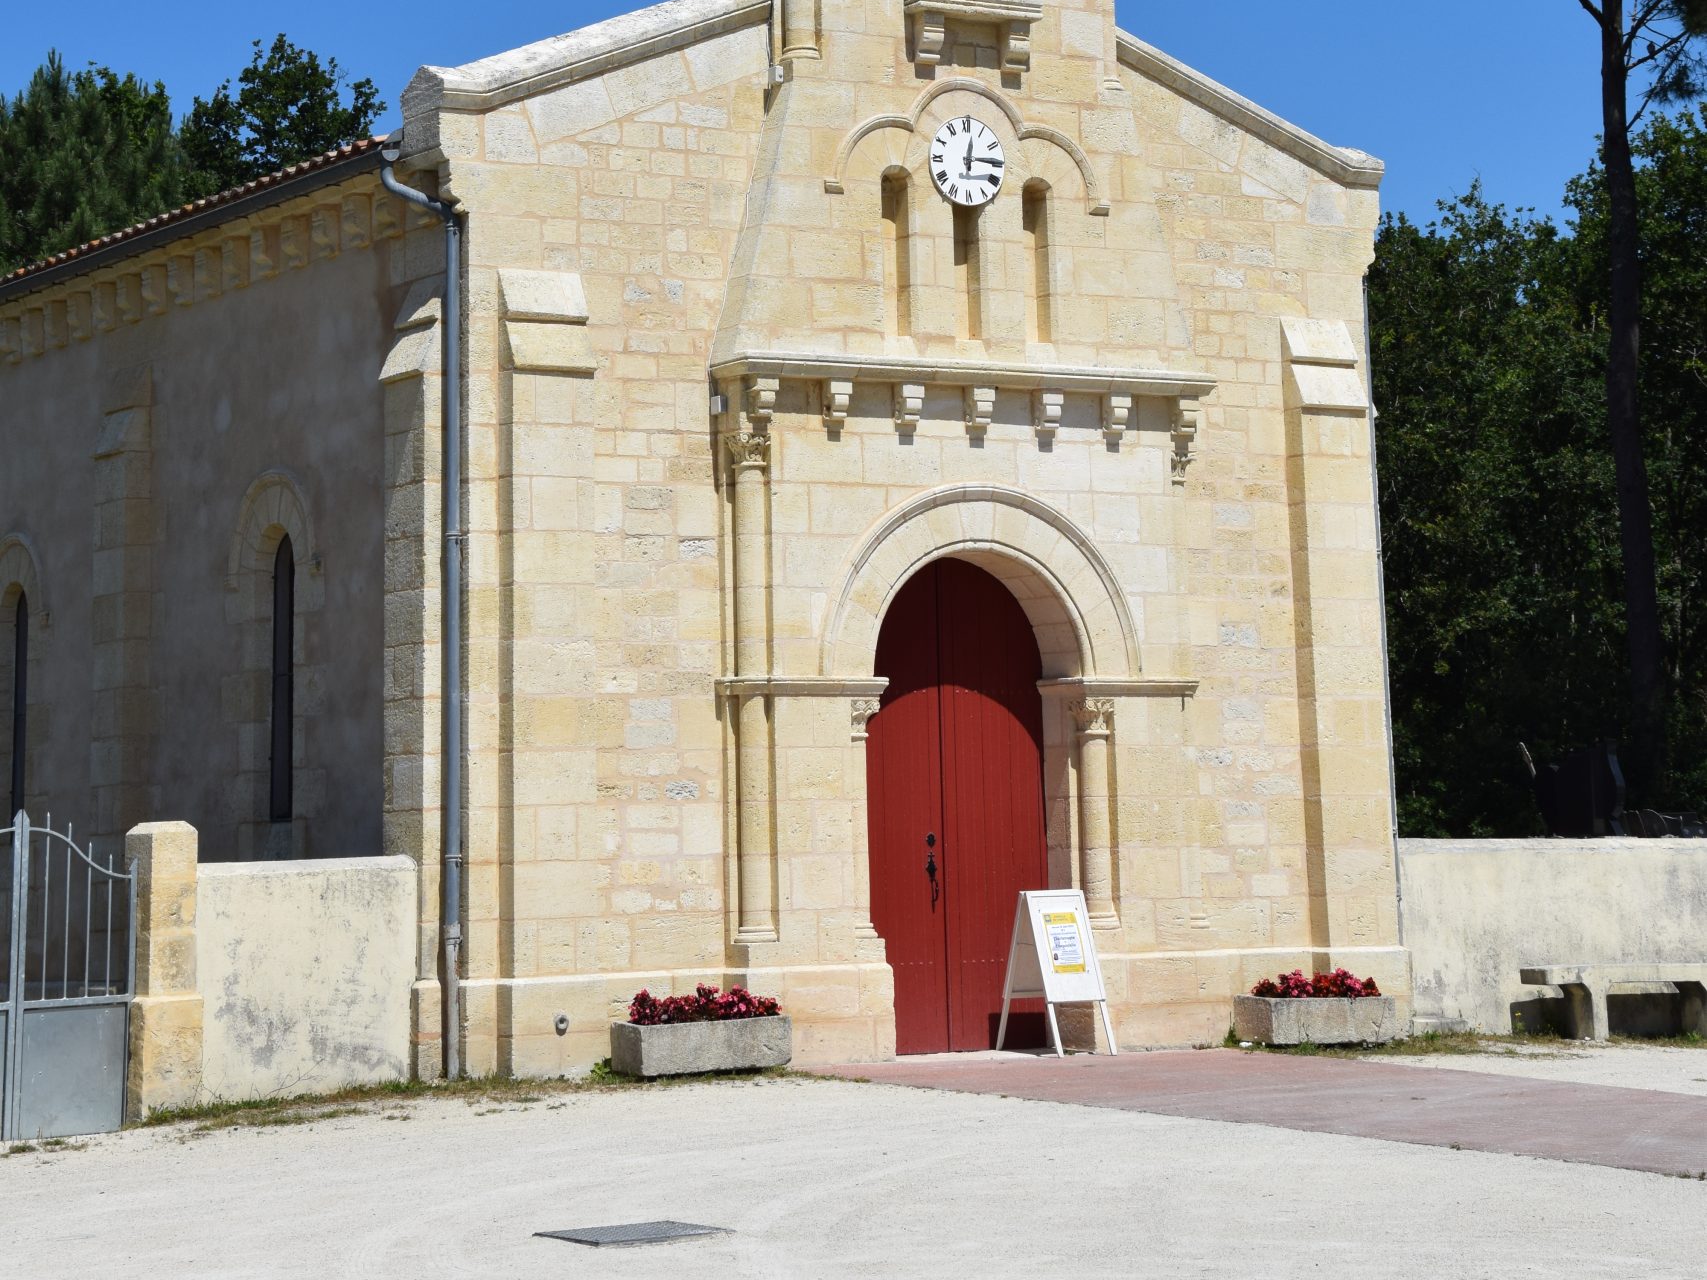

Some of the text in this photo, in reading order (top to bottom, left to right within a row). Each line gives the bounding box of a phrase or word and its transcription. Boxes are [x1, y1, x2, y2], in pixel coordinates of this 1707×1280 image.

[962, 120, 970, 133] XII
[978, 126, 985, 138] I
[936, 136, 947, 147] X
[987, 141, 998, 151] II
